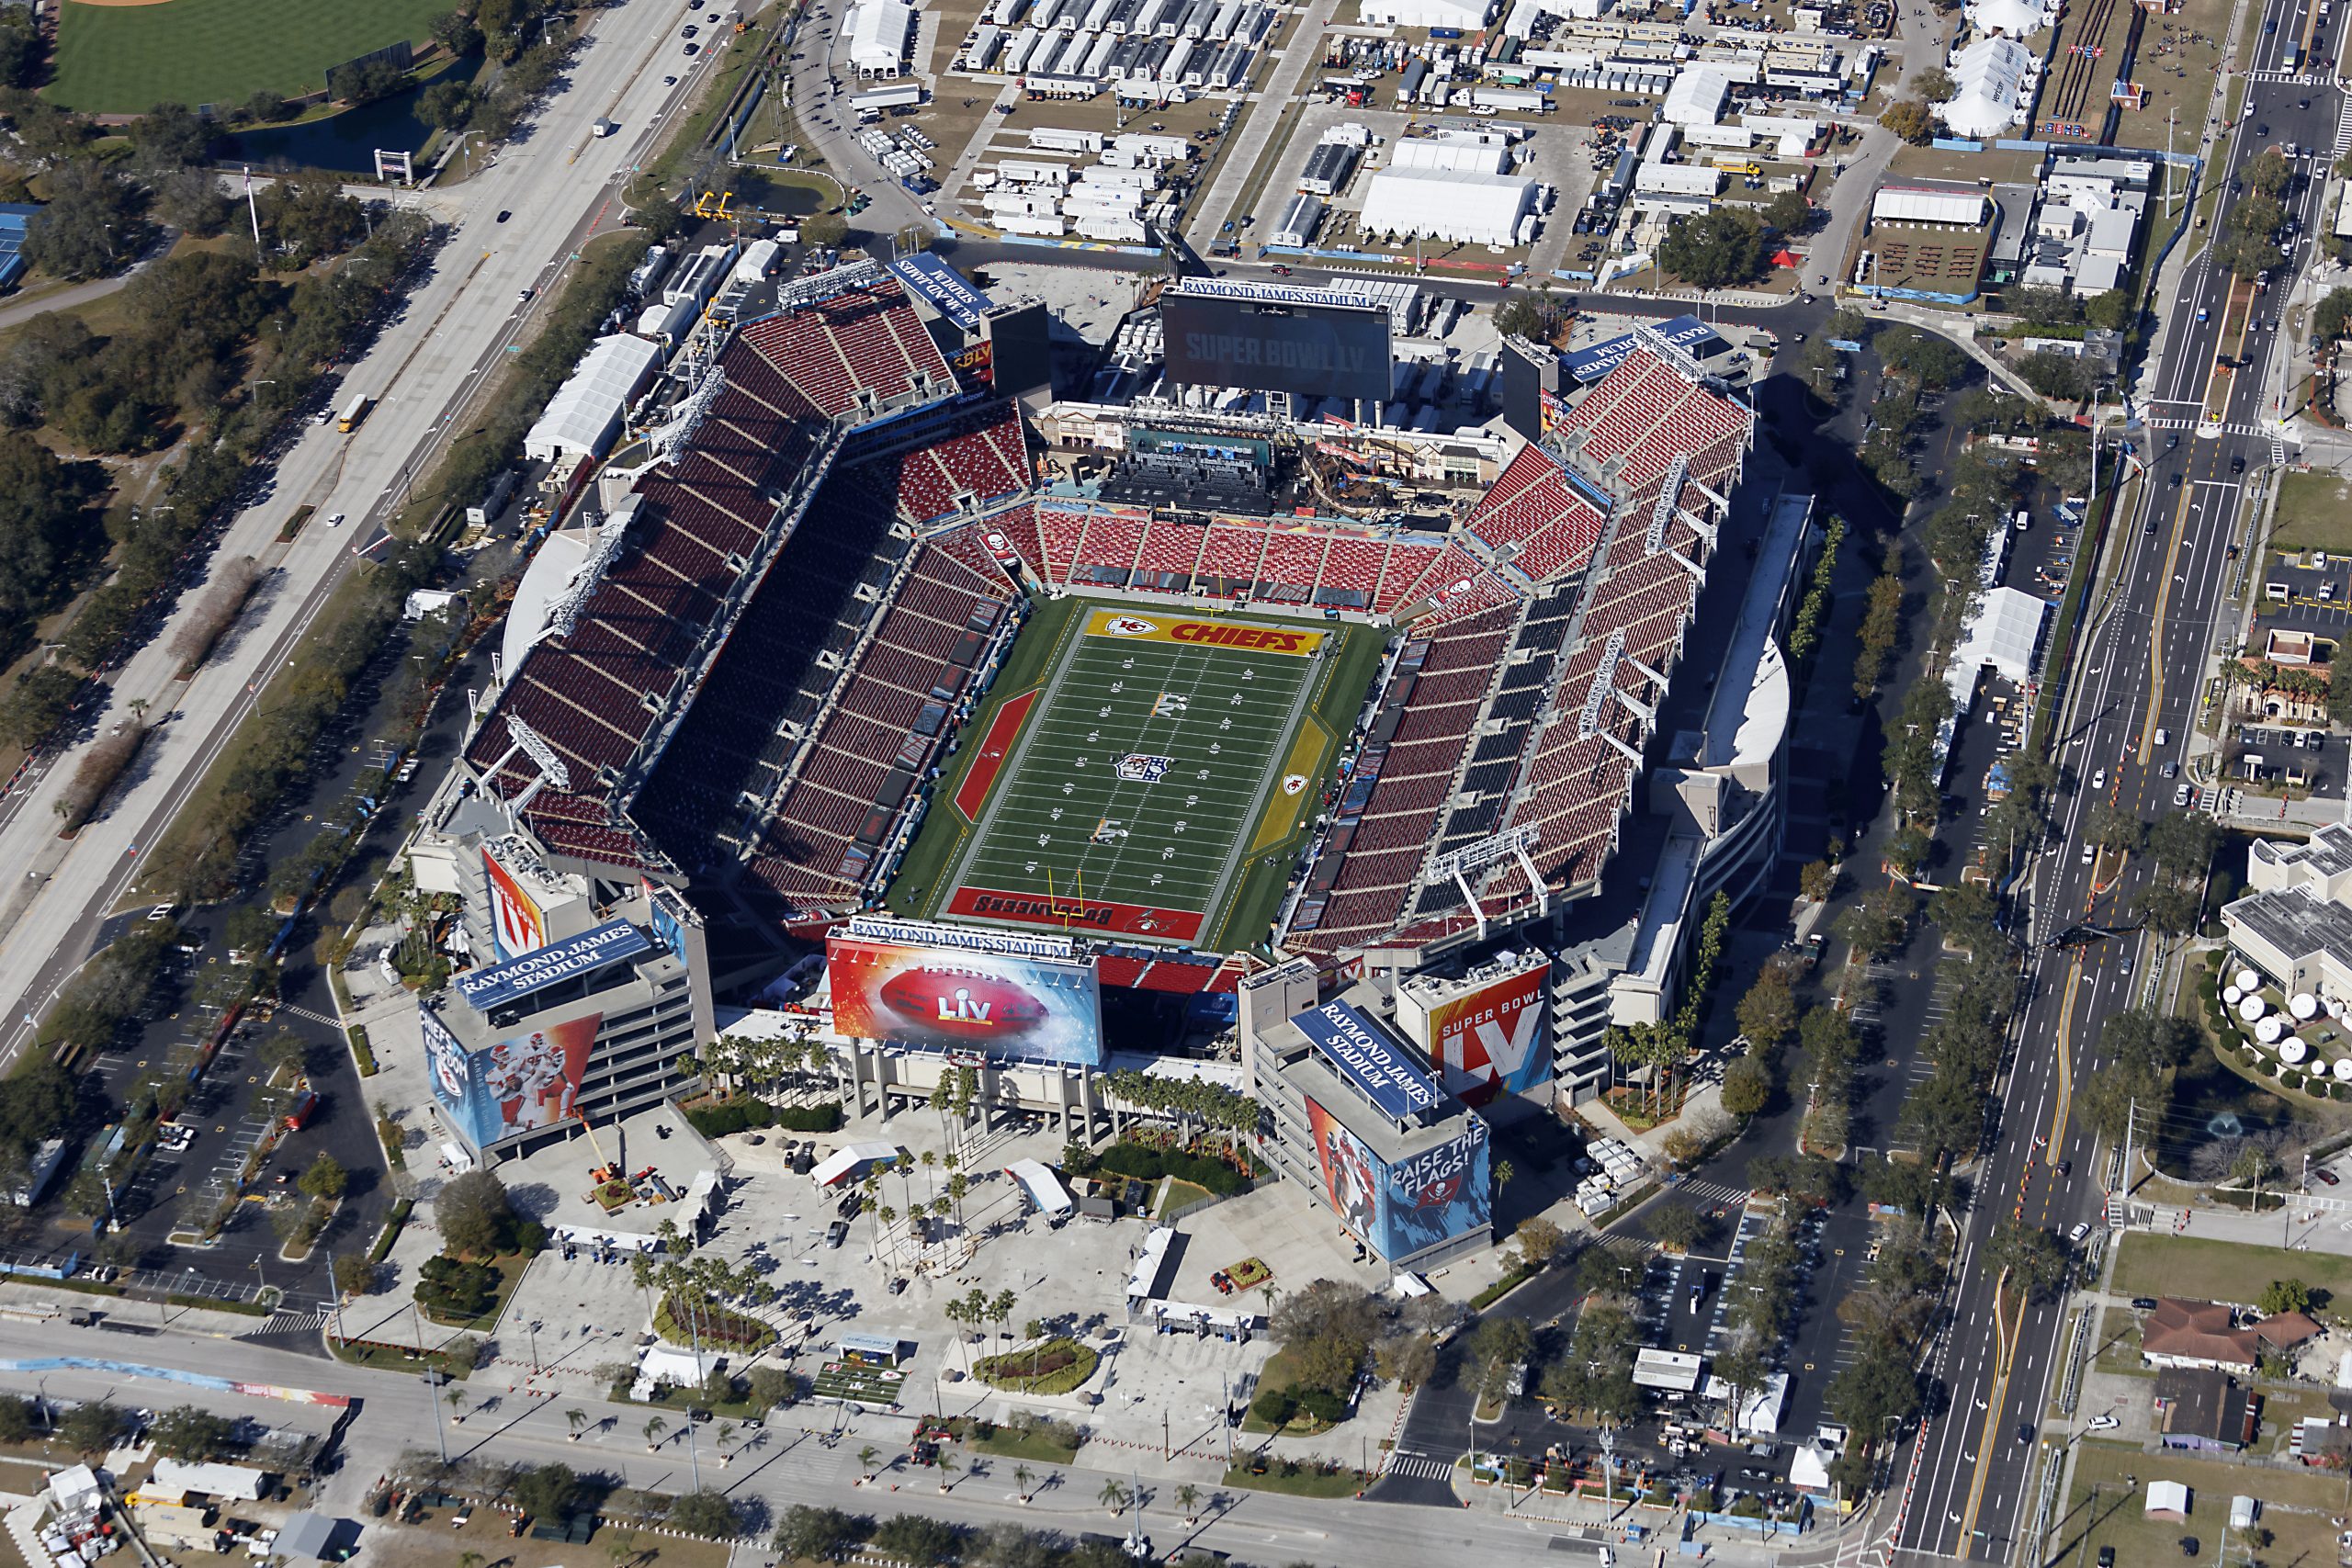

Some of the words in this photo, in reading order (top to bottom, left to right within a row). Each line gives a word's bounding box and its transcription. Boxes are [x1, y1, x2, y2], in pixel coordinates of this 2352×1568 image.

[2005, 46, 2015, 65] verizon
[1992, 81, 2005, 103] verizon
[895, 260, 933, 285] JAMES
[929, 269, 978, 304] STADIUM
[926, 284, 979, 324] RAYMOND
[1183, 282, 1256, 298] RAYMOND
[1257, 288, 1304, 301] JAMES
[1306, 291, 1366, 307] STADIUM
[1186, 332, 1261, 365] SUPER
[1265, 339, 1333, 368] BOWL
[1337, 344, 1364, 372] LV
[1574, 354, 1625, 377] JAMES
[956, 389, 986, 404] verizon
[1542, 394, 1564, 410] SUPER
[1118, 620, 1147, 634] KC
[1170, 623, 1306, 651] CHIEFS
[489, 874, 514, 911] SUPER
[516, 905, 540, 941] BOWL
[972, 894, 1114, 926] BUCCANEERS
[463, 949, 566, 994] RAYMOND
[568, 923, 634, 955] JAMES
[853, 923, 936, 942] RAYMOND
[942, 933, 994, 950] JAMES
[996, 939, 1069, 957] STADIUM
[512, 949, 604, 991] STADIUM
[419, 1010, 455, 1050] CHIEFS
[1442, 1008, 1493, 1037] SUPER
[1501, 988, 1545, 1014] BOWL
[424, 1032, 469, 1081] KINGDOM
[1320, 1002, 1392, 1066] RAYMOND
[1384, 1063, 1434, 1105] JAMES
[1326, 1034, 1390, 1089] STADIUM
[1442, 1000, 1544, 1098] LV
[472, 1057, 484, 1089] KANSAS
[1389, 1147, 1443, 1190] RAISE
[1449, 1126, 1485, 1156] THE
[1405, 1151, 1469, 1197] FLAGS!
